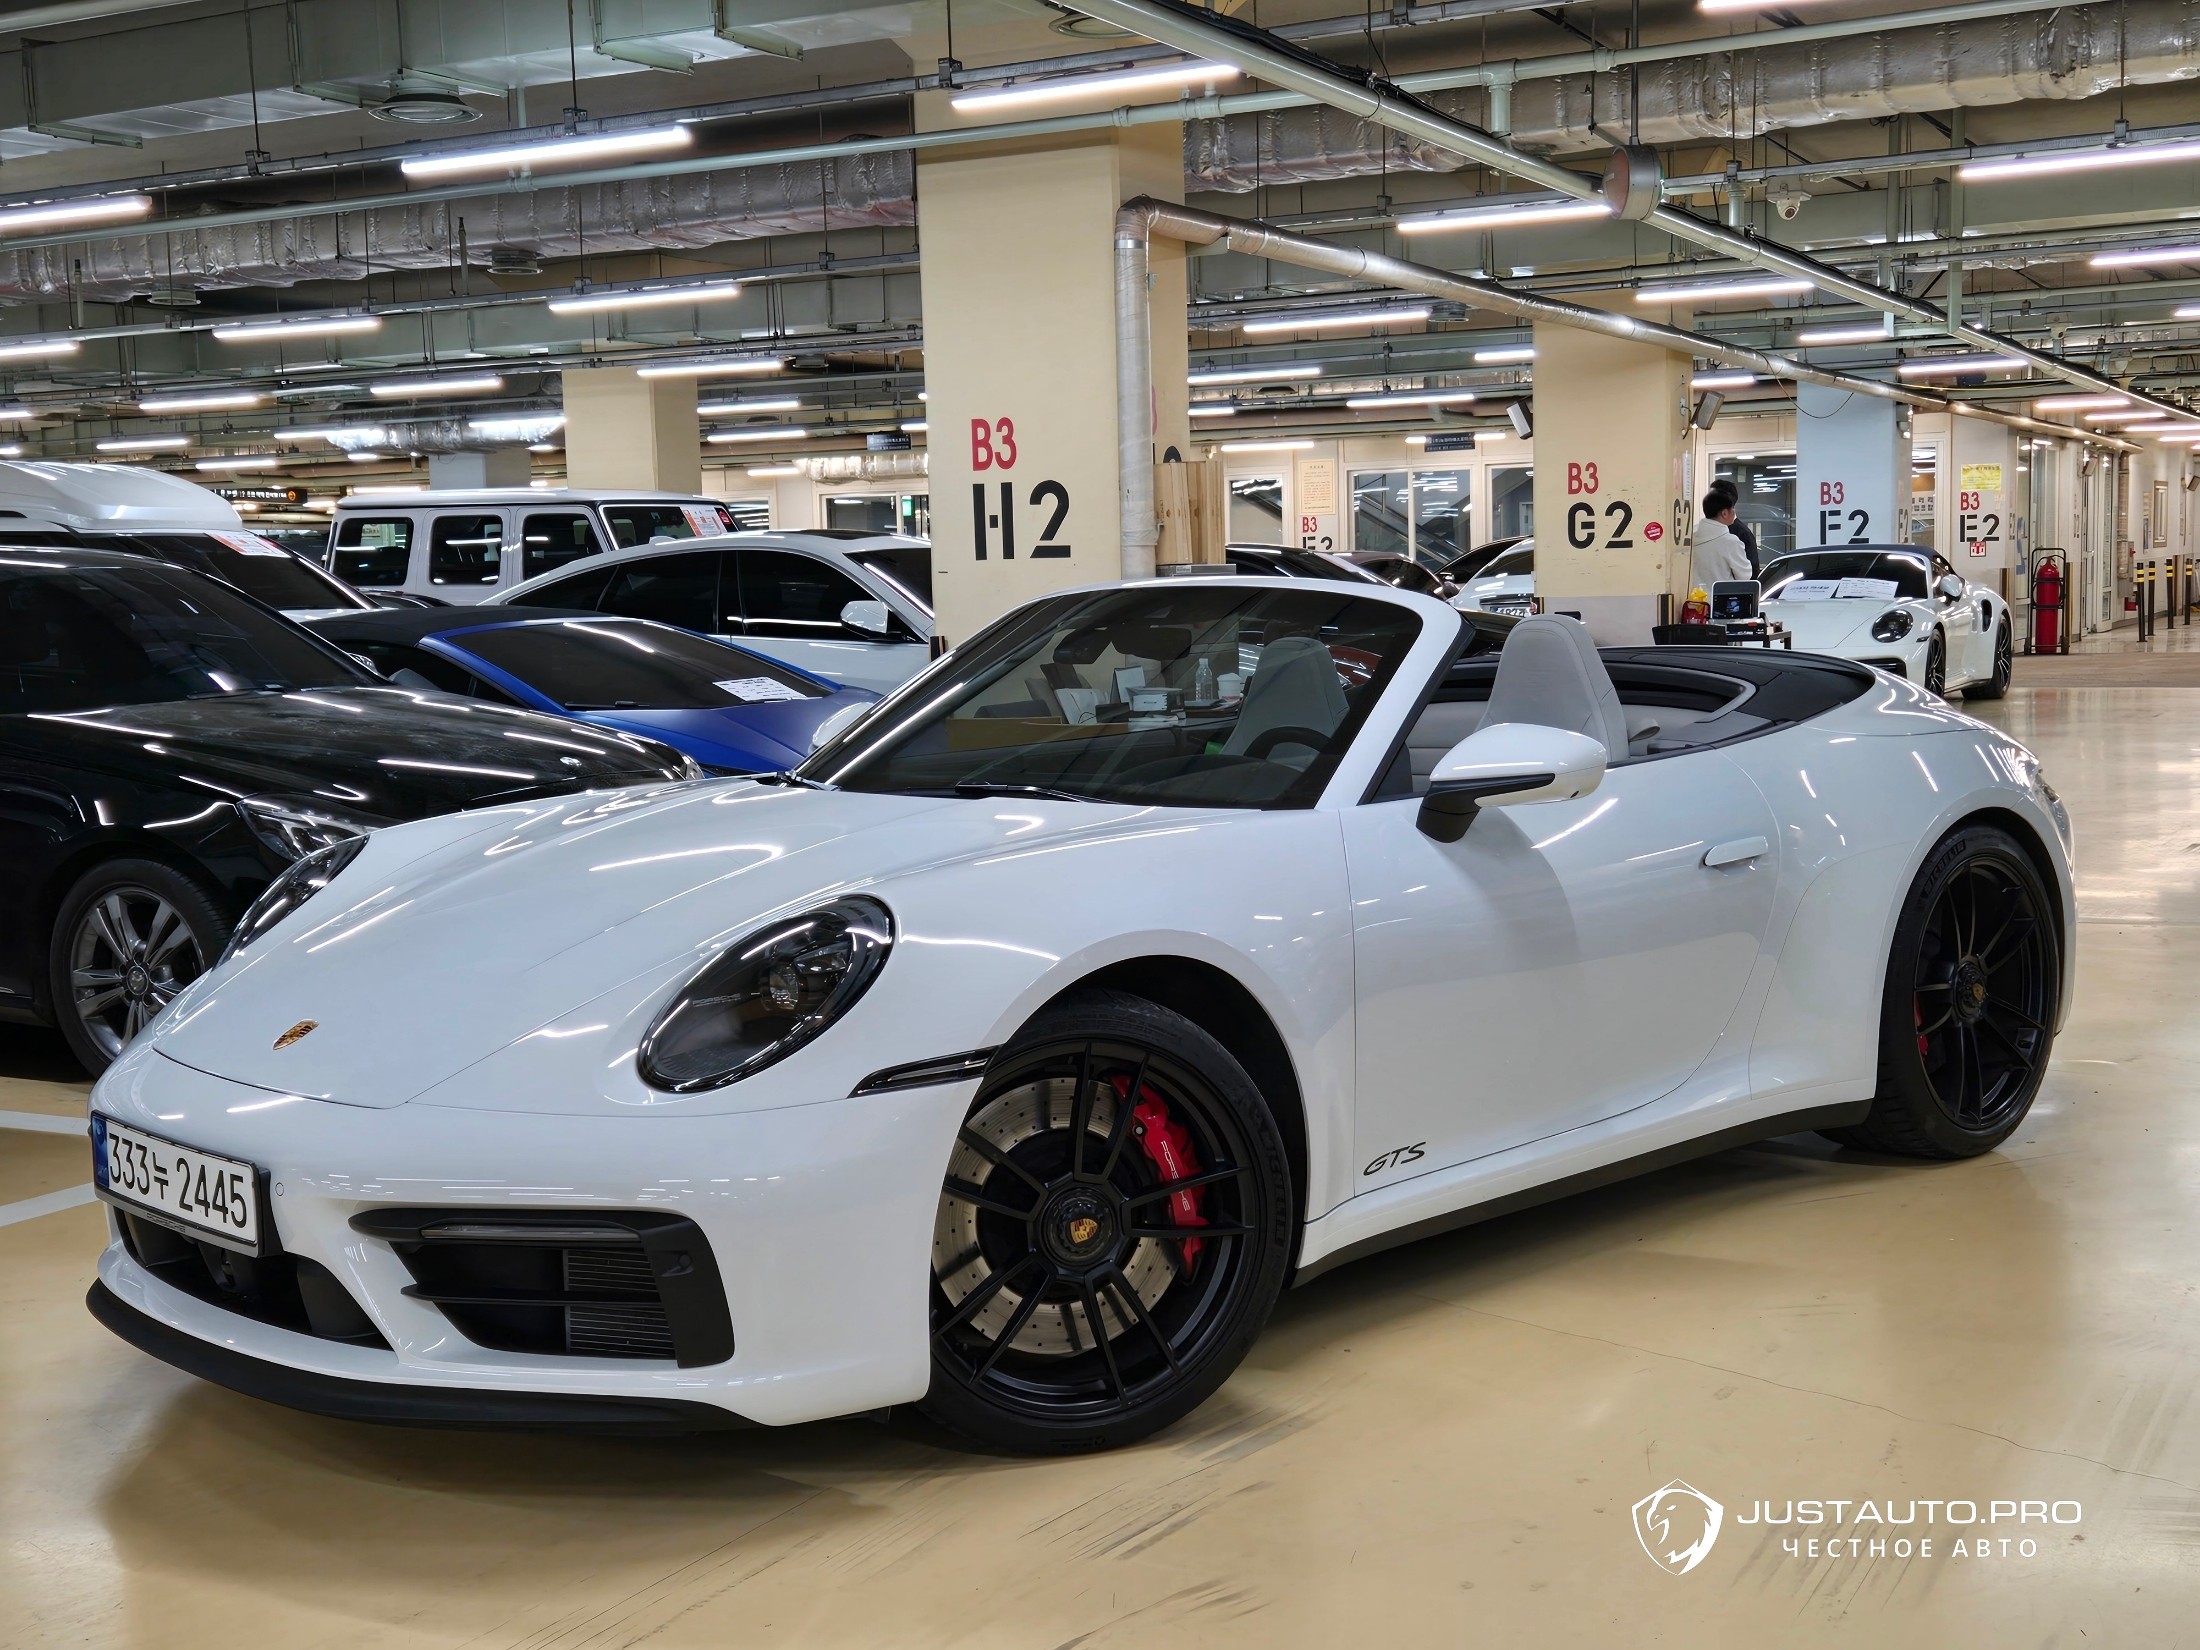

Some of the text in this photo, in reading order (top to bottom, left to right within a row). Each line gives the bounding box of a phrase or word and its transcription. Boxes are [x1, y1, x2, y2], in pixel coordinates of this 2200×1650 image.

[971, 416, 1017, 472] B3
[1566, 462, 1599, 495] B3
[1820, 481, 1845, 506] B3
[1960, 491, 1980, 511] B3
[972, 479, 1071, 561] H2
[1302, 516, 1318, 533] B3
[1567, 500, 1633, 550] G2
[1819, 509, 1870, 545] F2
[1959, 513, 2000, 543] E2
[1363, 1141, 1427, 1176] GTS
[109, 1132, 248, 1229] 333누 2445
